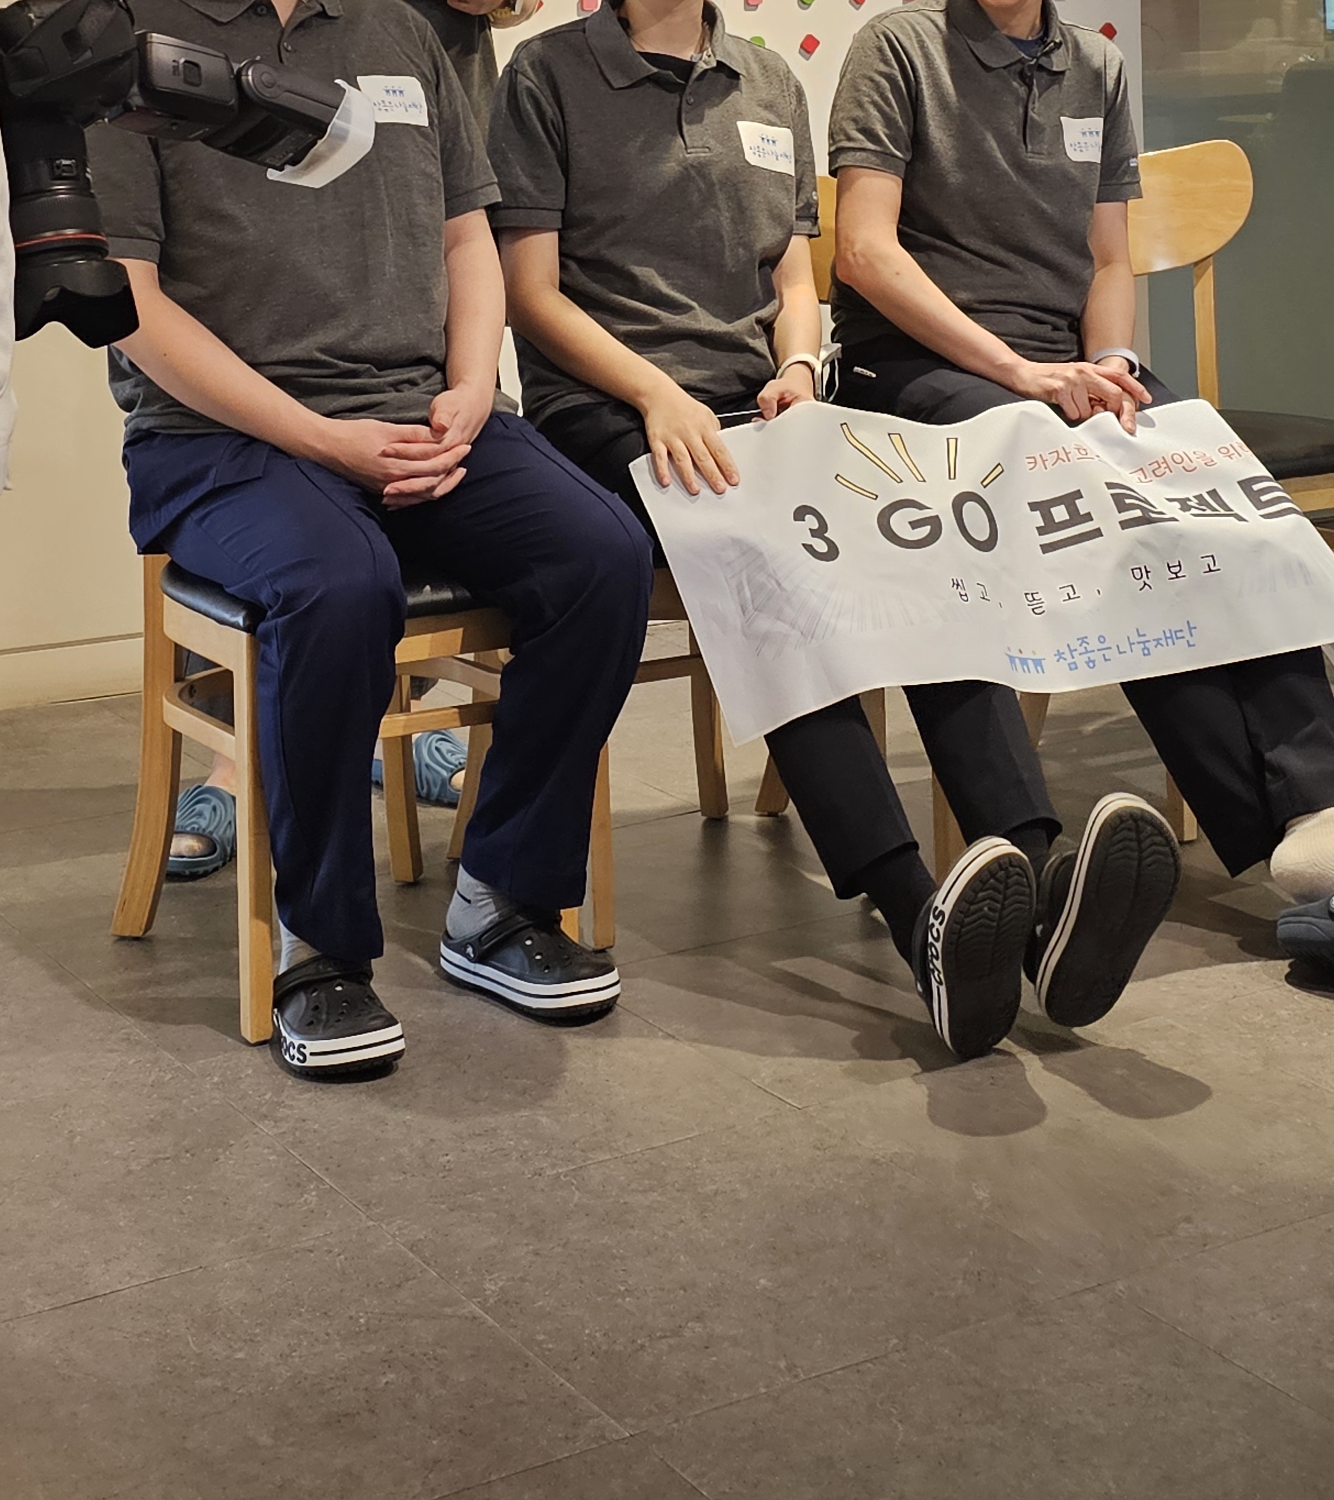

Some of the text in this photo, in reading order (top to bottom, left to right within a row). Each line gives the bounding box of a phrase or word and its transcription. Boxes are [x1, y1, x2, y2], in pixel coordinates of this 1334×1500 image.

[1025, 443, 1101, 471] 카자흐
[793, 474, 1307, 562] 3 GO 프로젝트
[1053, 620, 1198, 672] 참좋은나눔재단
